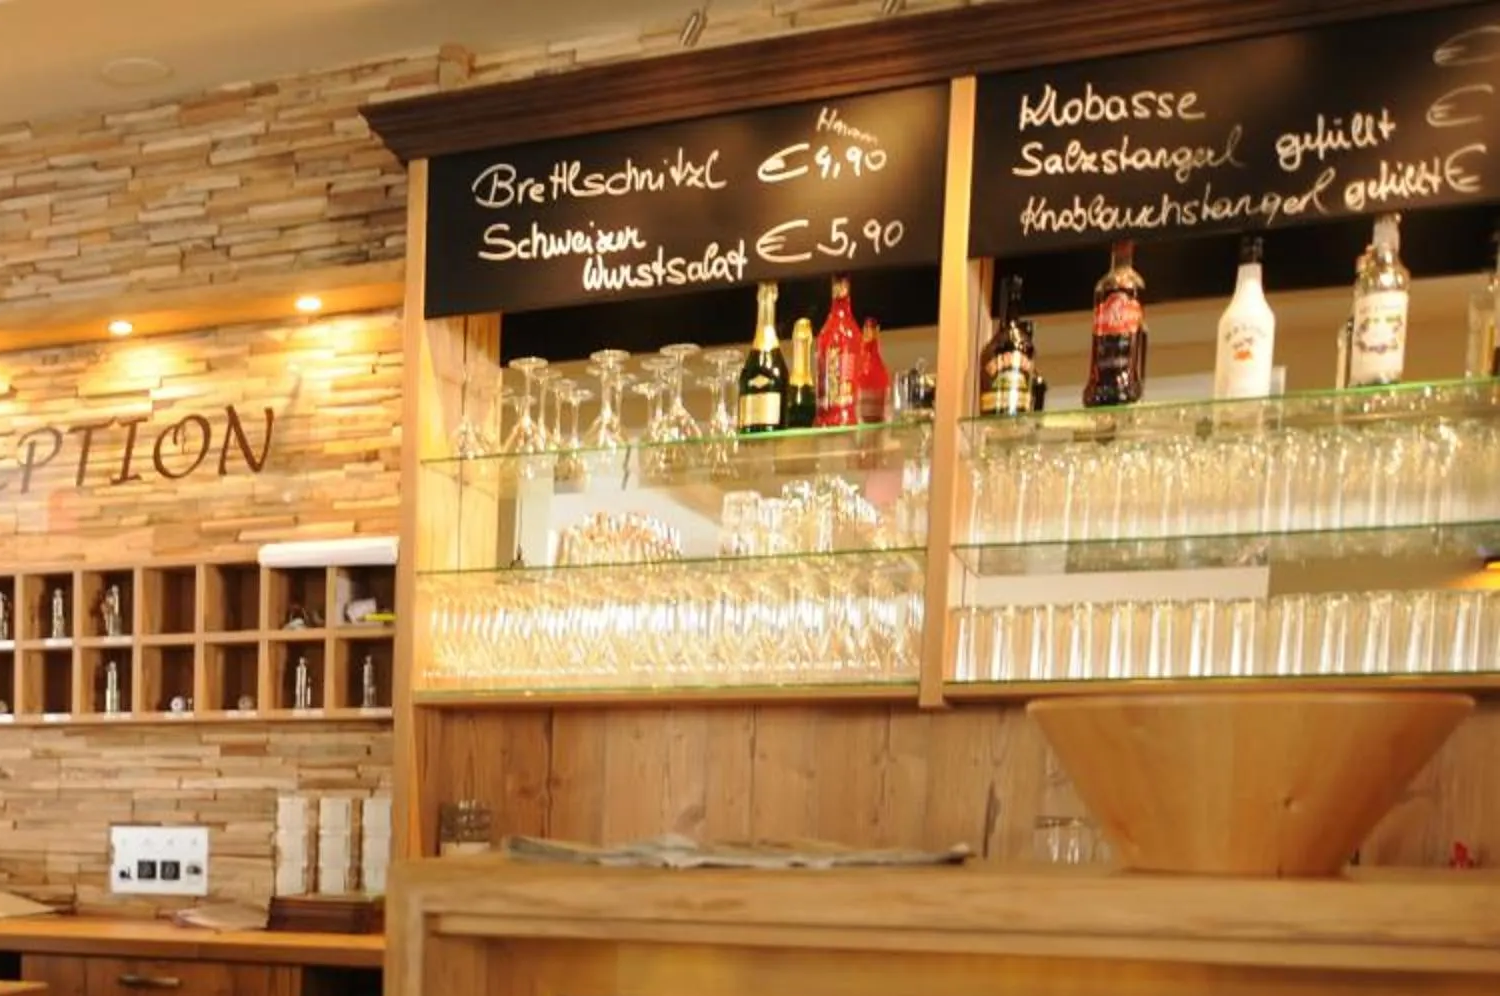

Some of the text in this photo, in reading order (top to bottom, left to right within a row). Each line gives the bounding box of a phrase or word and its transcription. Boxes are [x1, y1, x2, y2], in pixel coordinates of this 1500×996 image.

[1019, 84, 1205, 130] Klobasse
[1275, 108, 1396, 172] gefüllt
[478, 220, 647, 260] Schweizer
[582, 239, 749, 291] Wurstsalat
